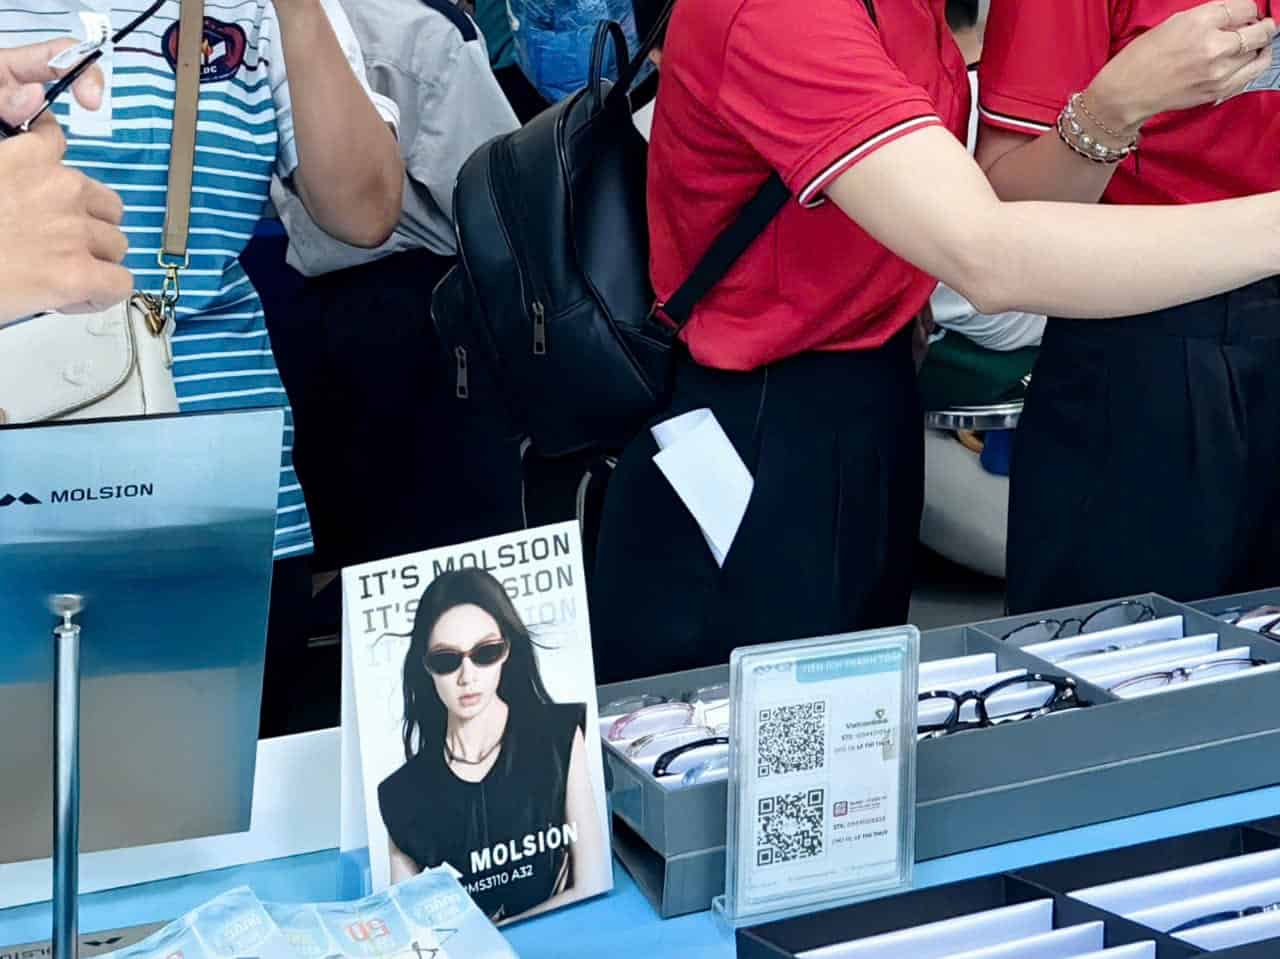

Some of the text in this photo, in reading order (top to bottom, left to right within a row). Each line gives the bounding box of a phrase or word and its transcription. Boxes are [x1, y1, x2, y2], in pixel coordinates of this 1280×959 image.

[50, 482, 154, 504] MOLSION
[358, 565, 420, 600] IT'S
[361, 564, 574, 634] IT'S SION
[469, 821, 578, 874] MOLSION
[511, 864, 534, 881] A32
